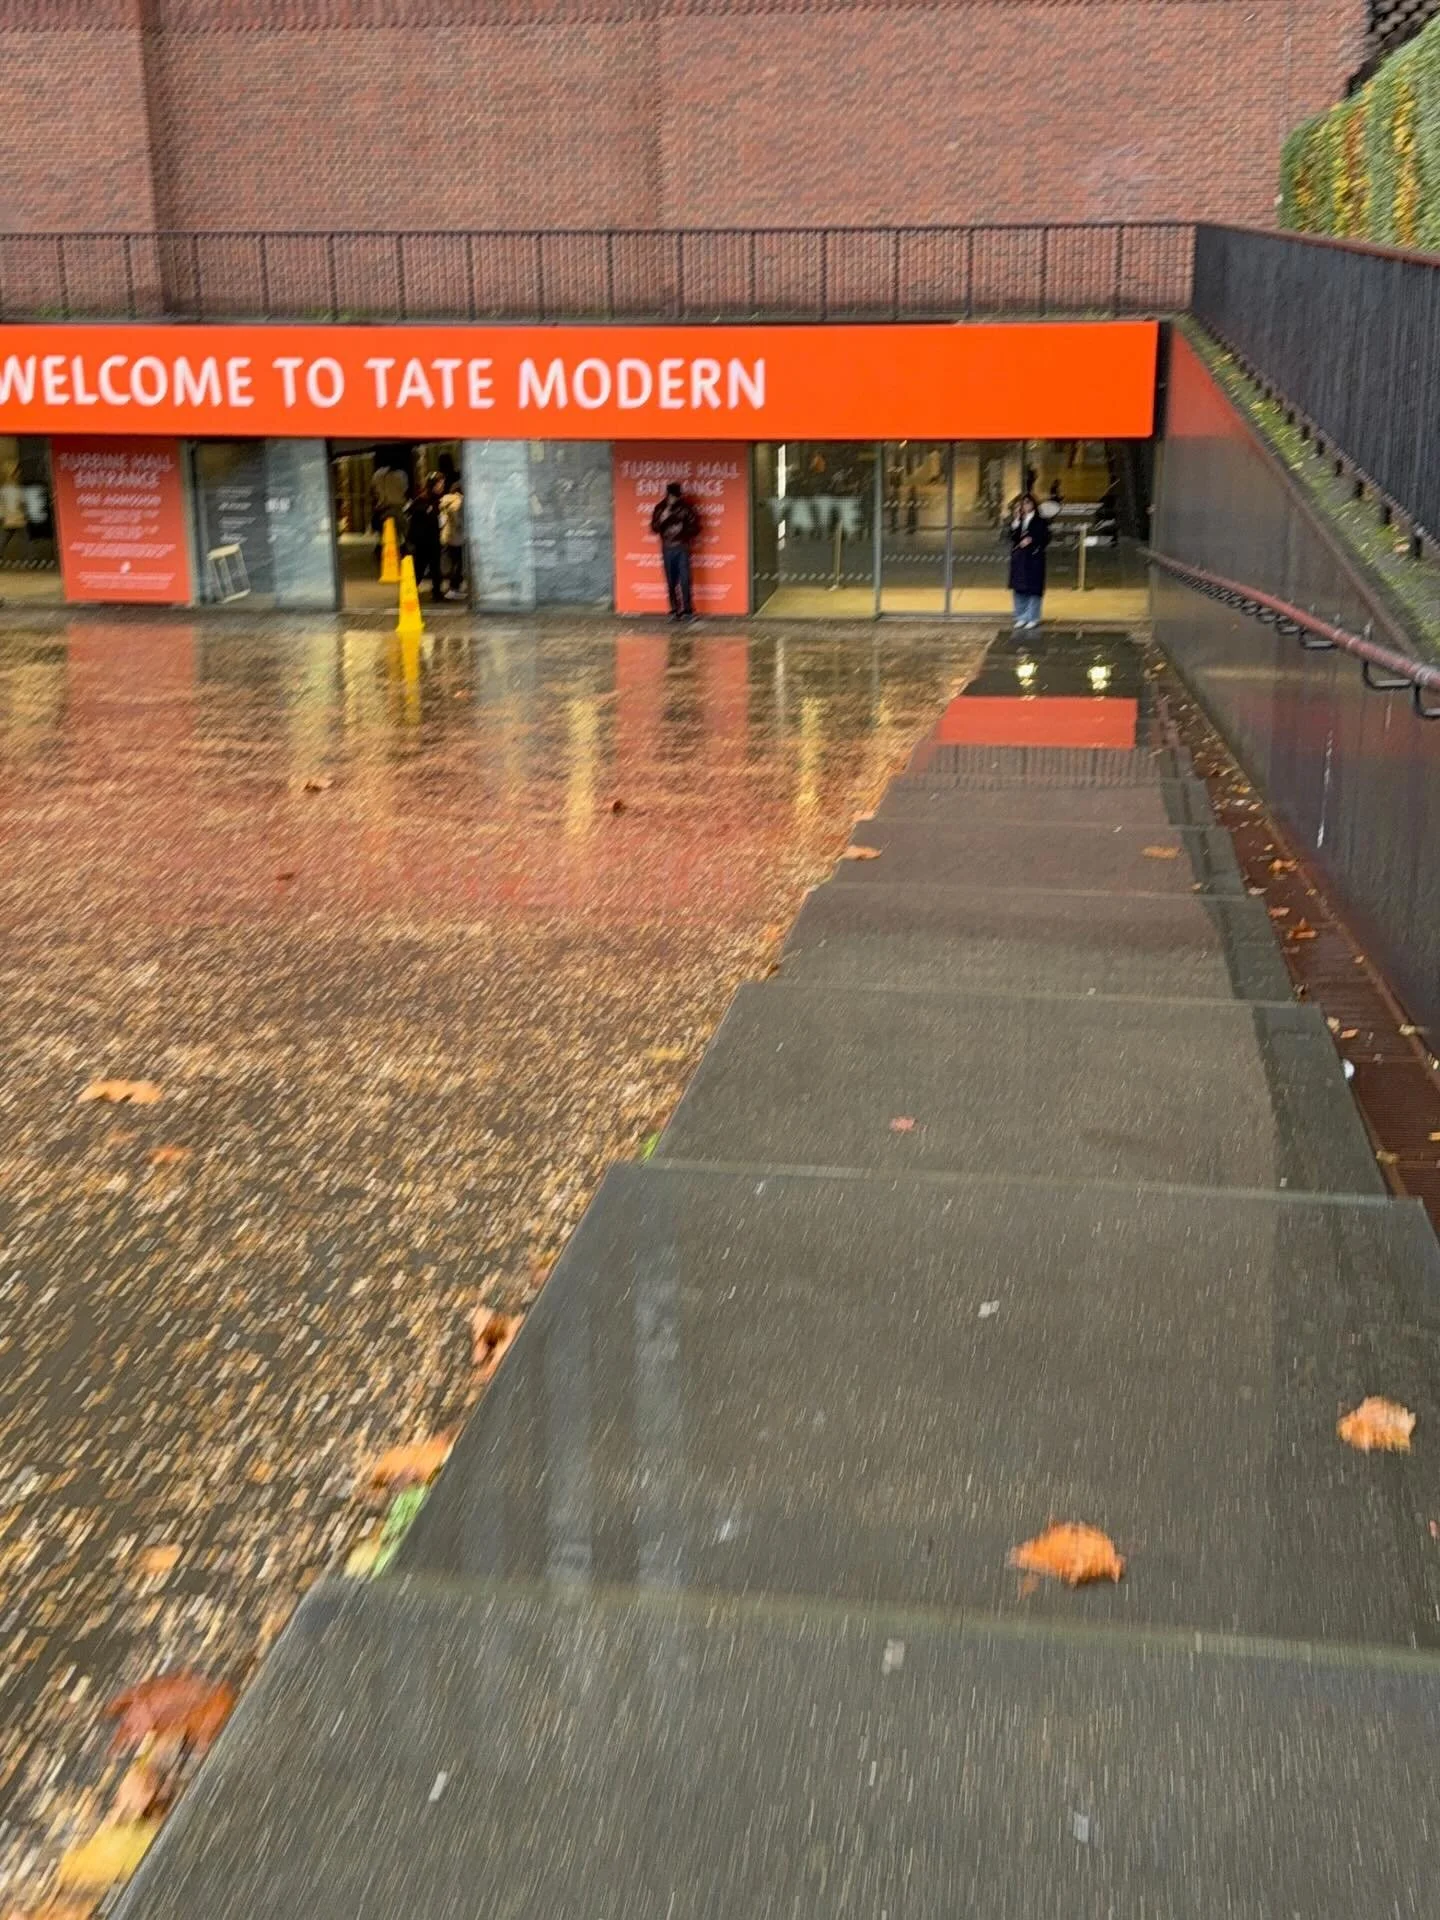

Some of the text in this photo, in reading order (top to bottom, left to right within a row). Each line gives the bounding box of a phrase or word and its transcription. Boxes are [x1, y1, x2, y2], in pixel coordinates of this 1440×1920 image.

[0, 355, 766, 410] WELCOME TO TATE MODERN
[620, 460, 741, 480] TURBINE HALL
[636, 479, 724, 496] ENTANCE
